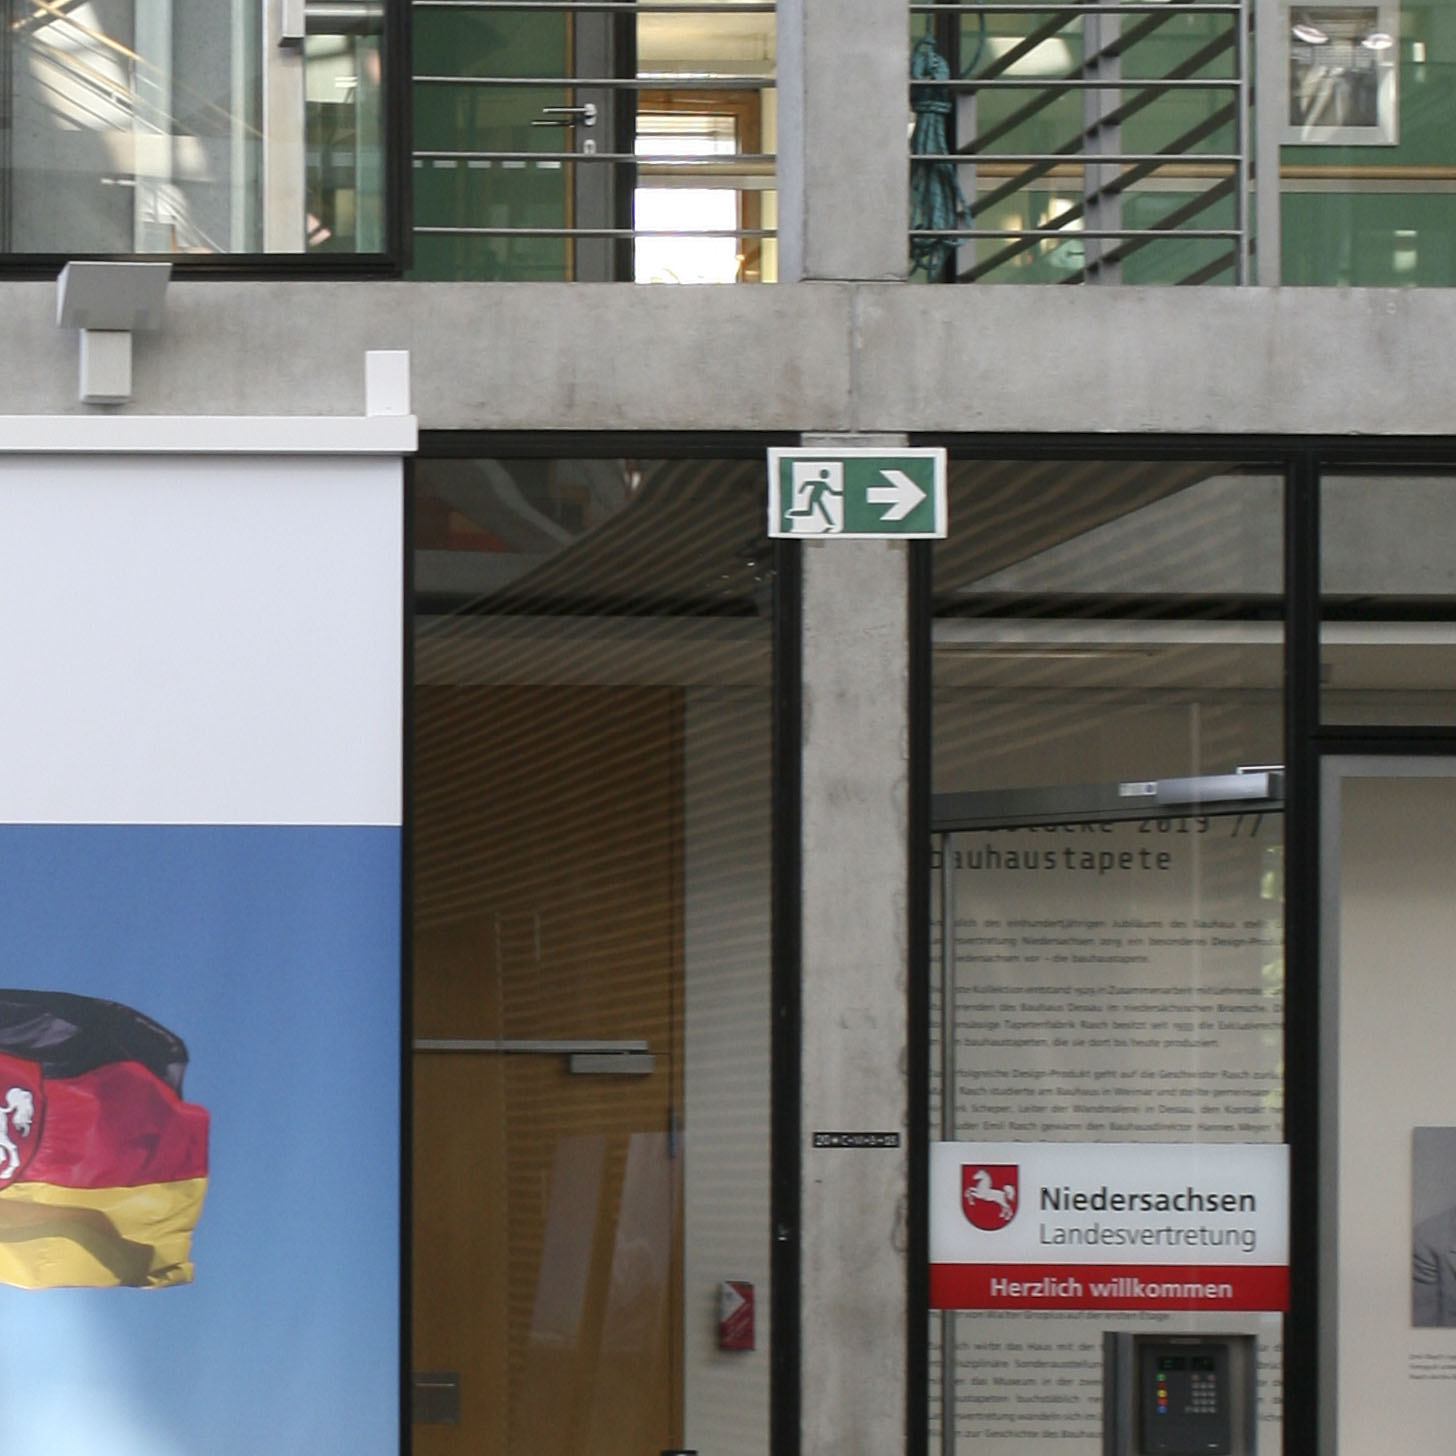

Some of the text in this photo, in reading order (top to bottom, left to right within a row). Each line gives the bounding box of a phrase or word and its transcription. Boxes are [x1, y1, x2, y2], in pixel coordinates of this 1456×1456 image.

[1039, 1187, 1256, 1213] Niedersachsen
[1039, 1223, 1256, 1252] Landesvertretung
[990, 1277, 1233, 1299] Herzlich willkommen
